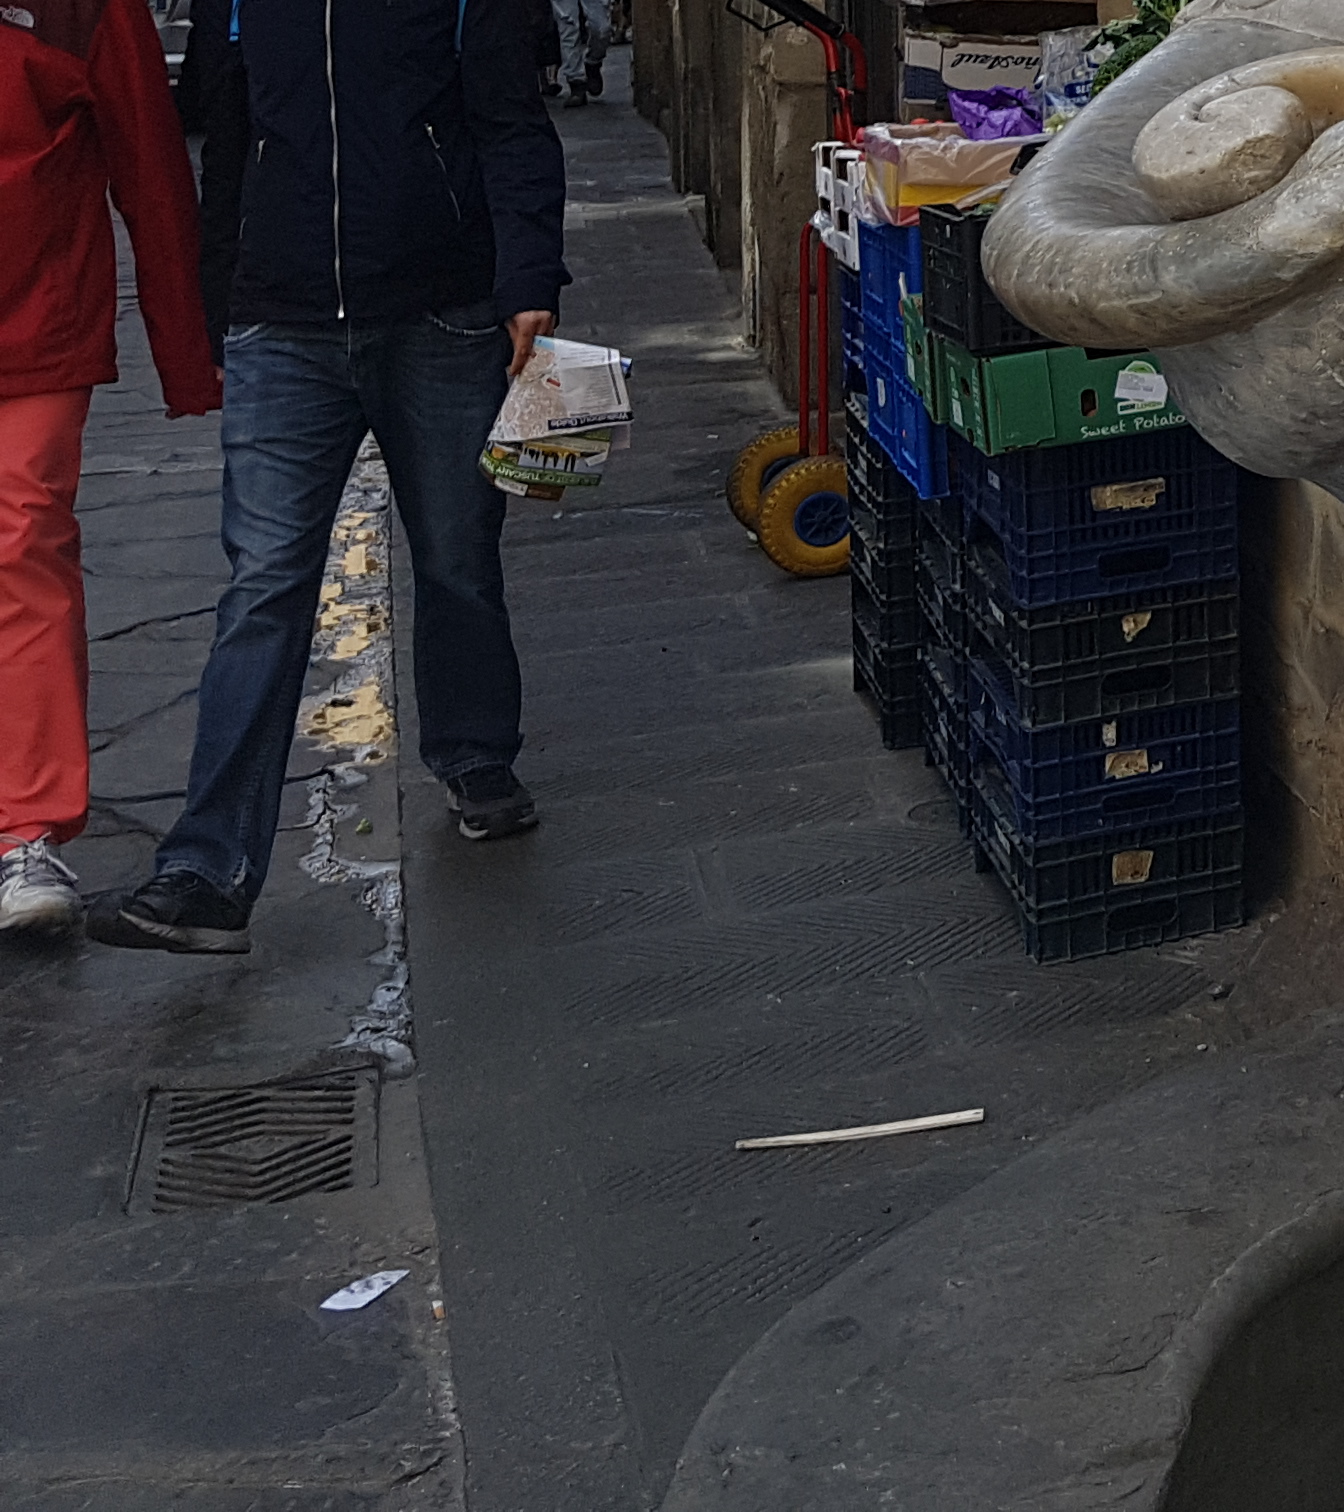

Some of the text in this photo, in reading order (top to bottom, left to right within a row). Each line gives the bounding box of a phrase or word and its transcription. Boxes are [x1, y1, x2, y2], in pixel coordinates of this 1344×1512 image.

[951, 52, 1040, 70] ñoAzul
[1080, 412, 1186, 439] Sweet Potato
[495, 466, 540, 482] TUSCANY
